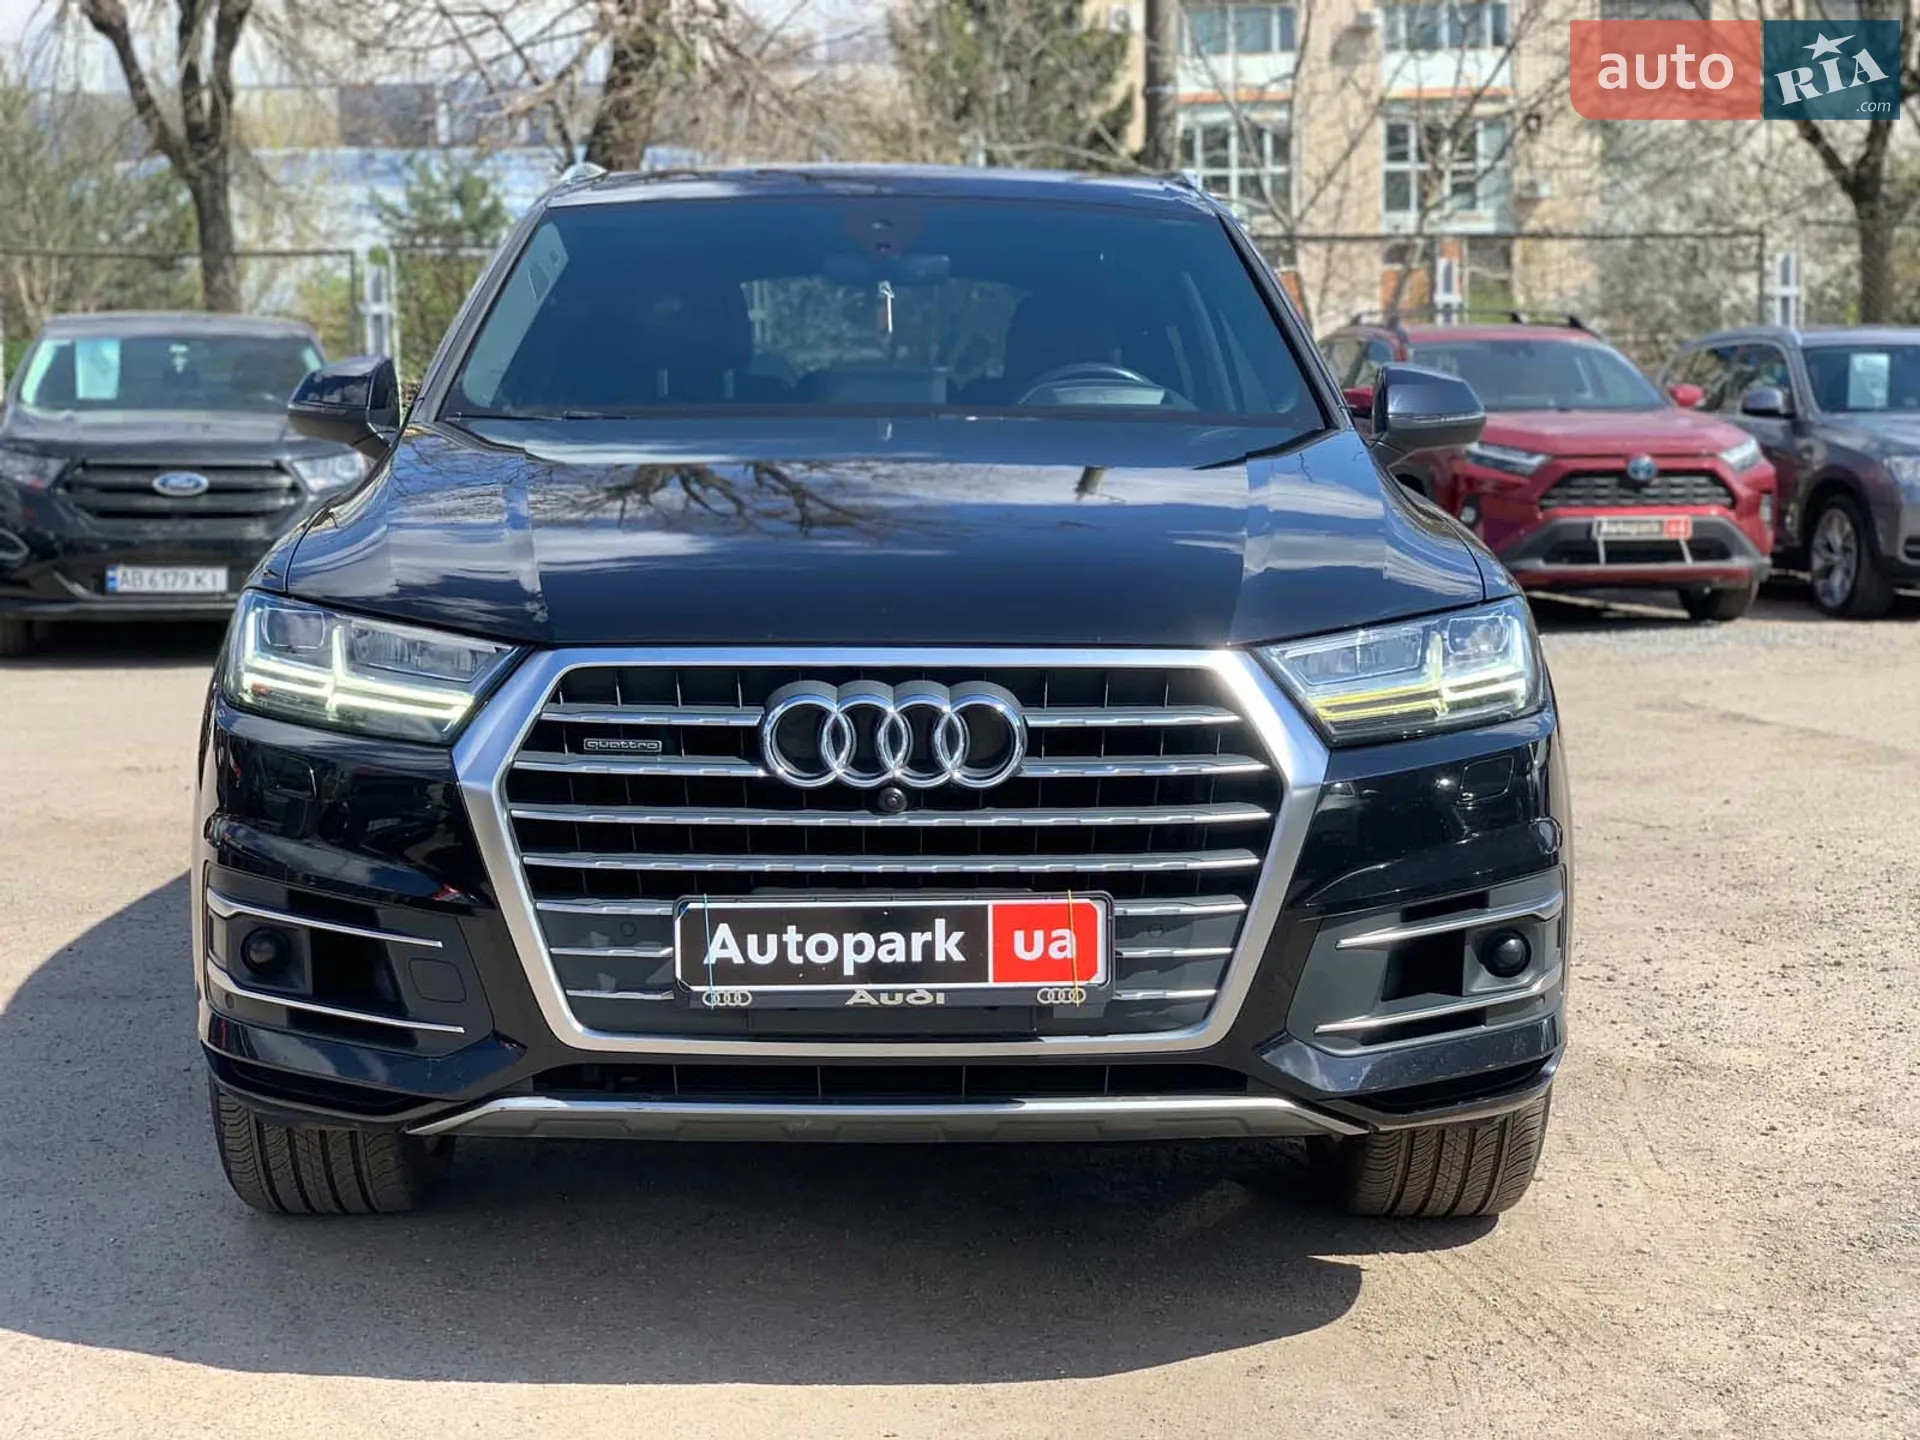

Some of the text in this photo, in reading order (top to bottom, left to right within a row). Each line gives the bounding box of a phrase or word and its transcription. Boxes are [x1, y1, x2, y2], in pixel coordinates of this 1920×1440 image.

[586, 741, 658, 750] quattro
[703, 918, 1077, 976] Autopark ua
[844, 989, 945, 1005] Audi
